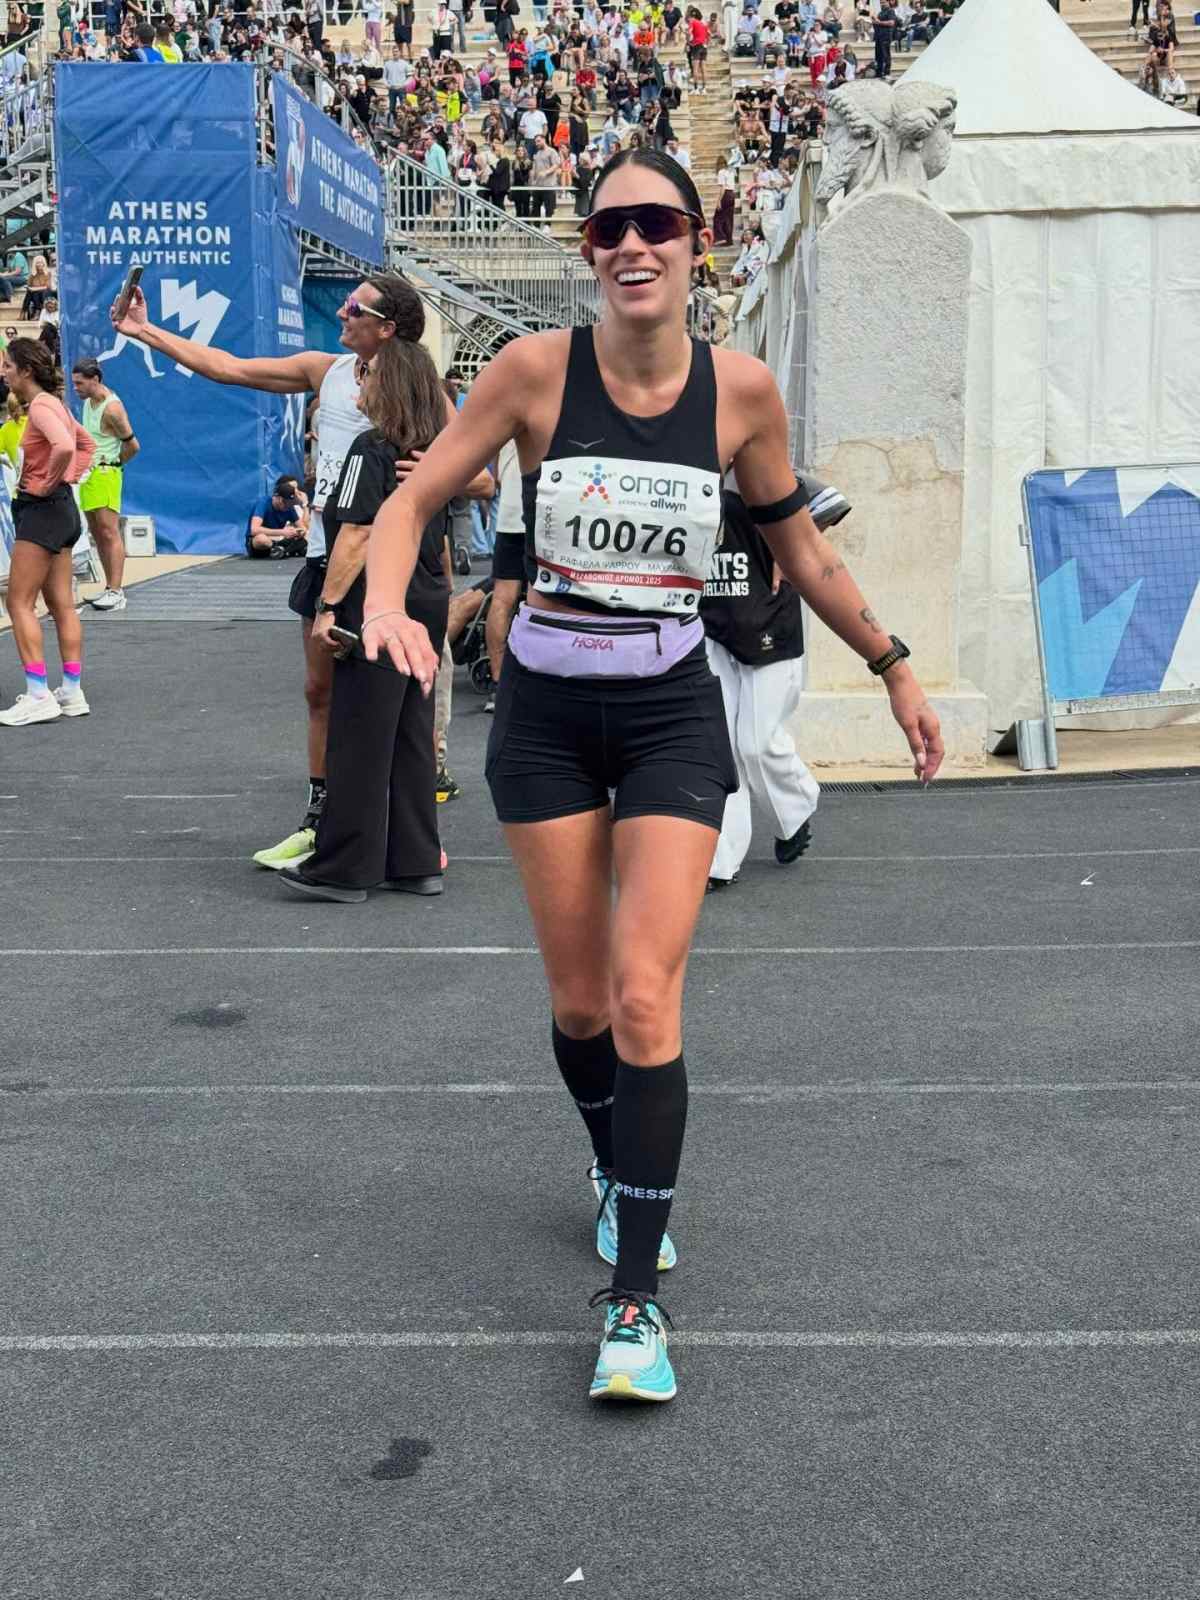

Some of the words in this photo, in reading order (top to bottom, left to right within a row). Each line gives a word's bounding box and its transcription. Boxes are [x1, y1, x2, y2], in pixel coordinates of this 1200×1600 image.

[311, 135, 343, 182] ATHENS
[319, 179, 335, 214] THE
[108, 201, 208, 220] ATHENS
[86, 226, 231, 245] MARATHON
[87, 251, 123, 265] THE
[129, 251, 231, 265] AUTHENTIC
[650, 498, 687, 513] allwyn
[565, 515, 688, 557] 10076
[571, 635, 614, 651] HOKA
